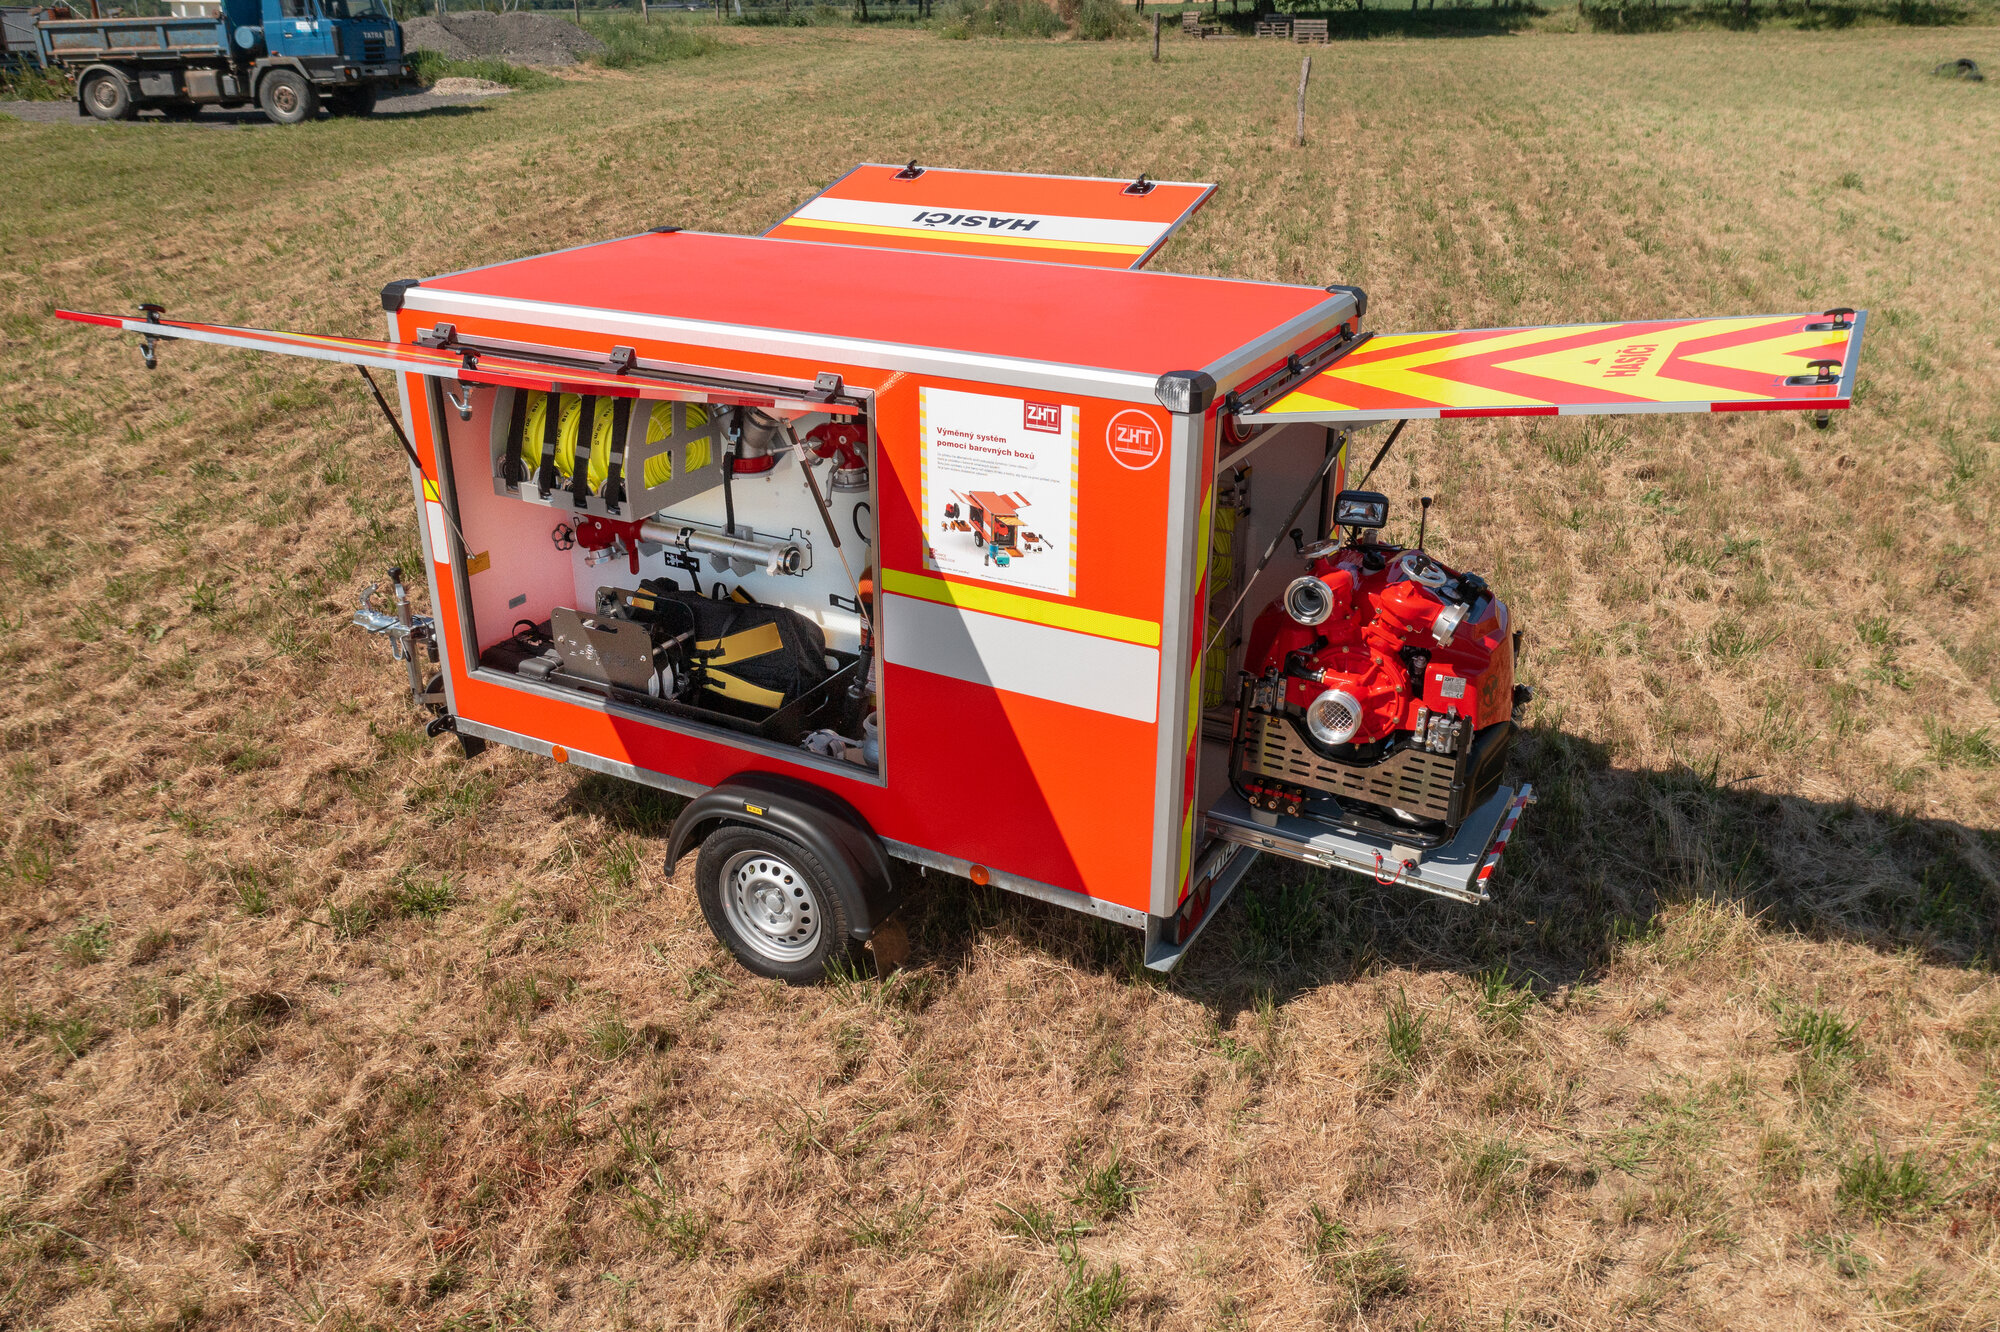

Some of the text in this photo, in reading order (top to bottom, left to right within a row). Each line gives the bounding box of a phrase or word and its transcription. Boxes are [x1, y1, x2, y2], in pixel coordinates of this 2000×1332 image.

[363, 31, 384, 39] TATRA
[912, 211, 1040, 231] HASIČI
[1602, 344, 1660, 378] HASIČI
[1027, 405, 1058, 423] ZHT
[936, 426, 1007, 444] Výměnný systém
[1116, 426, 1153, 446] ZHT
[937, 440, 1036, 460] pomocí barevných boxů
